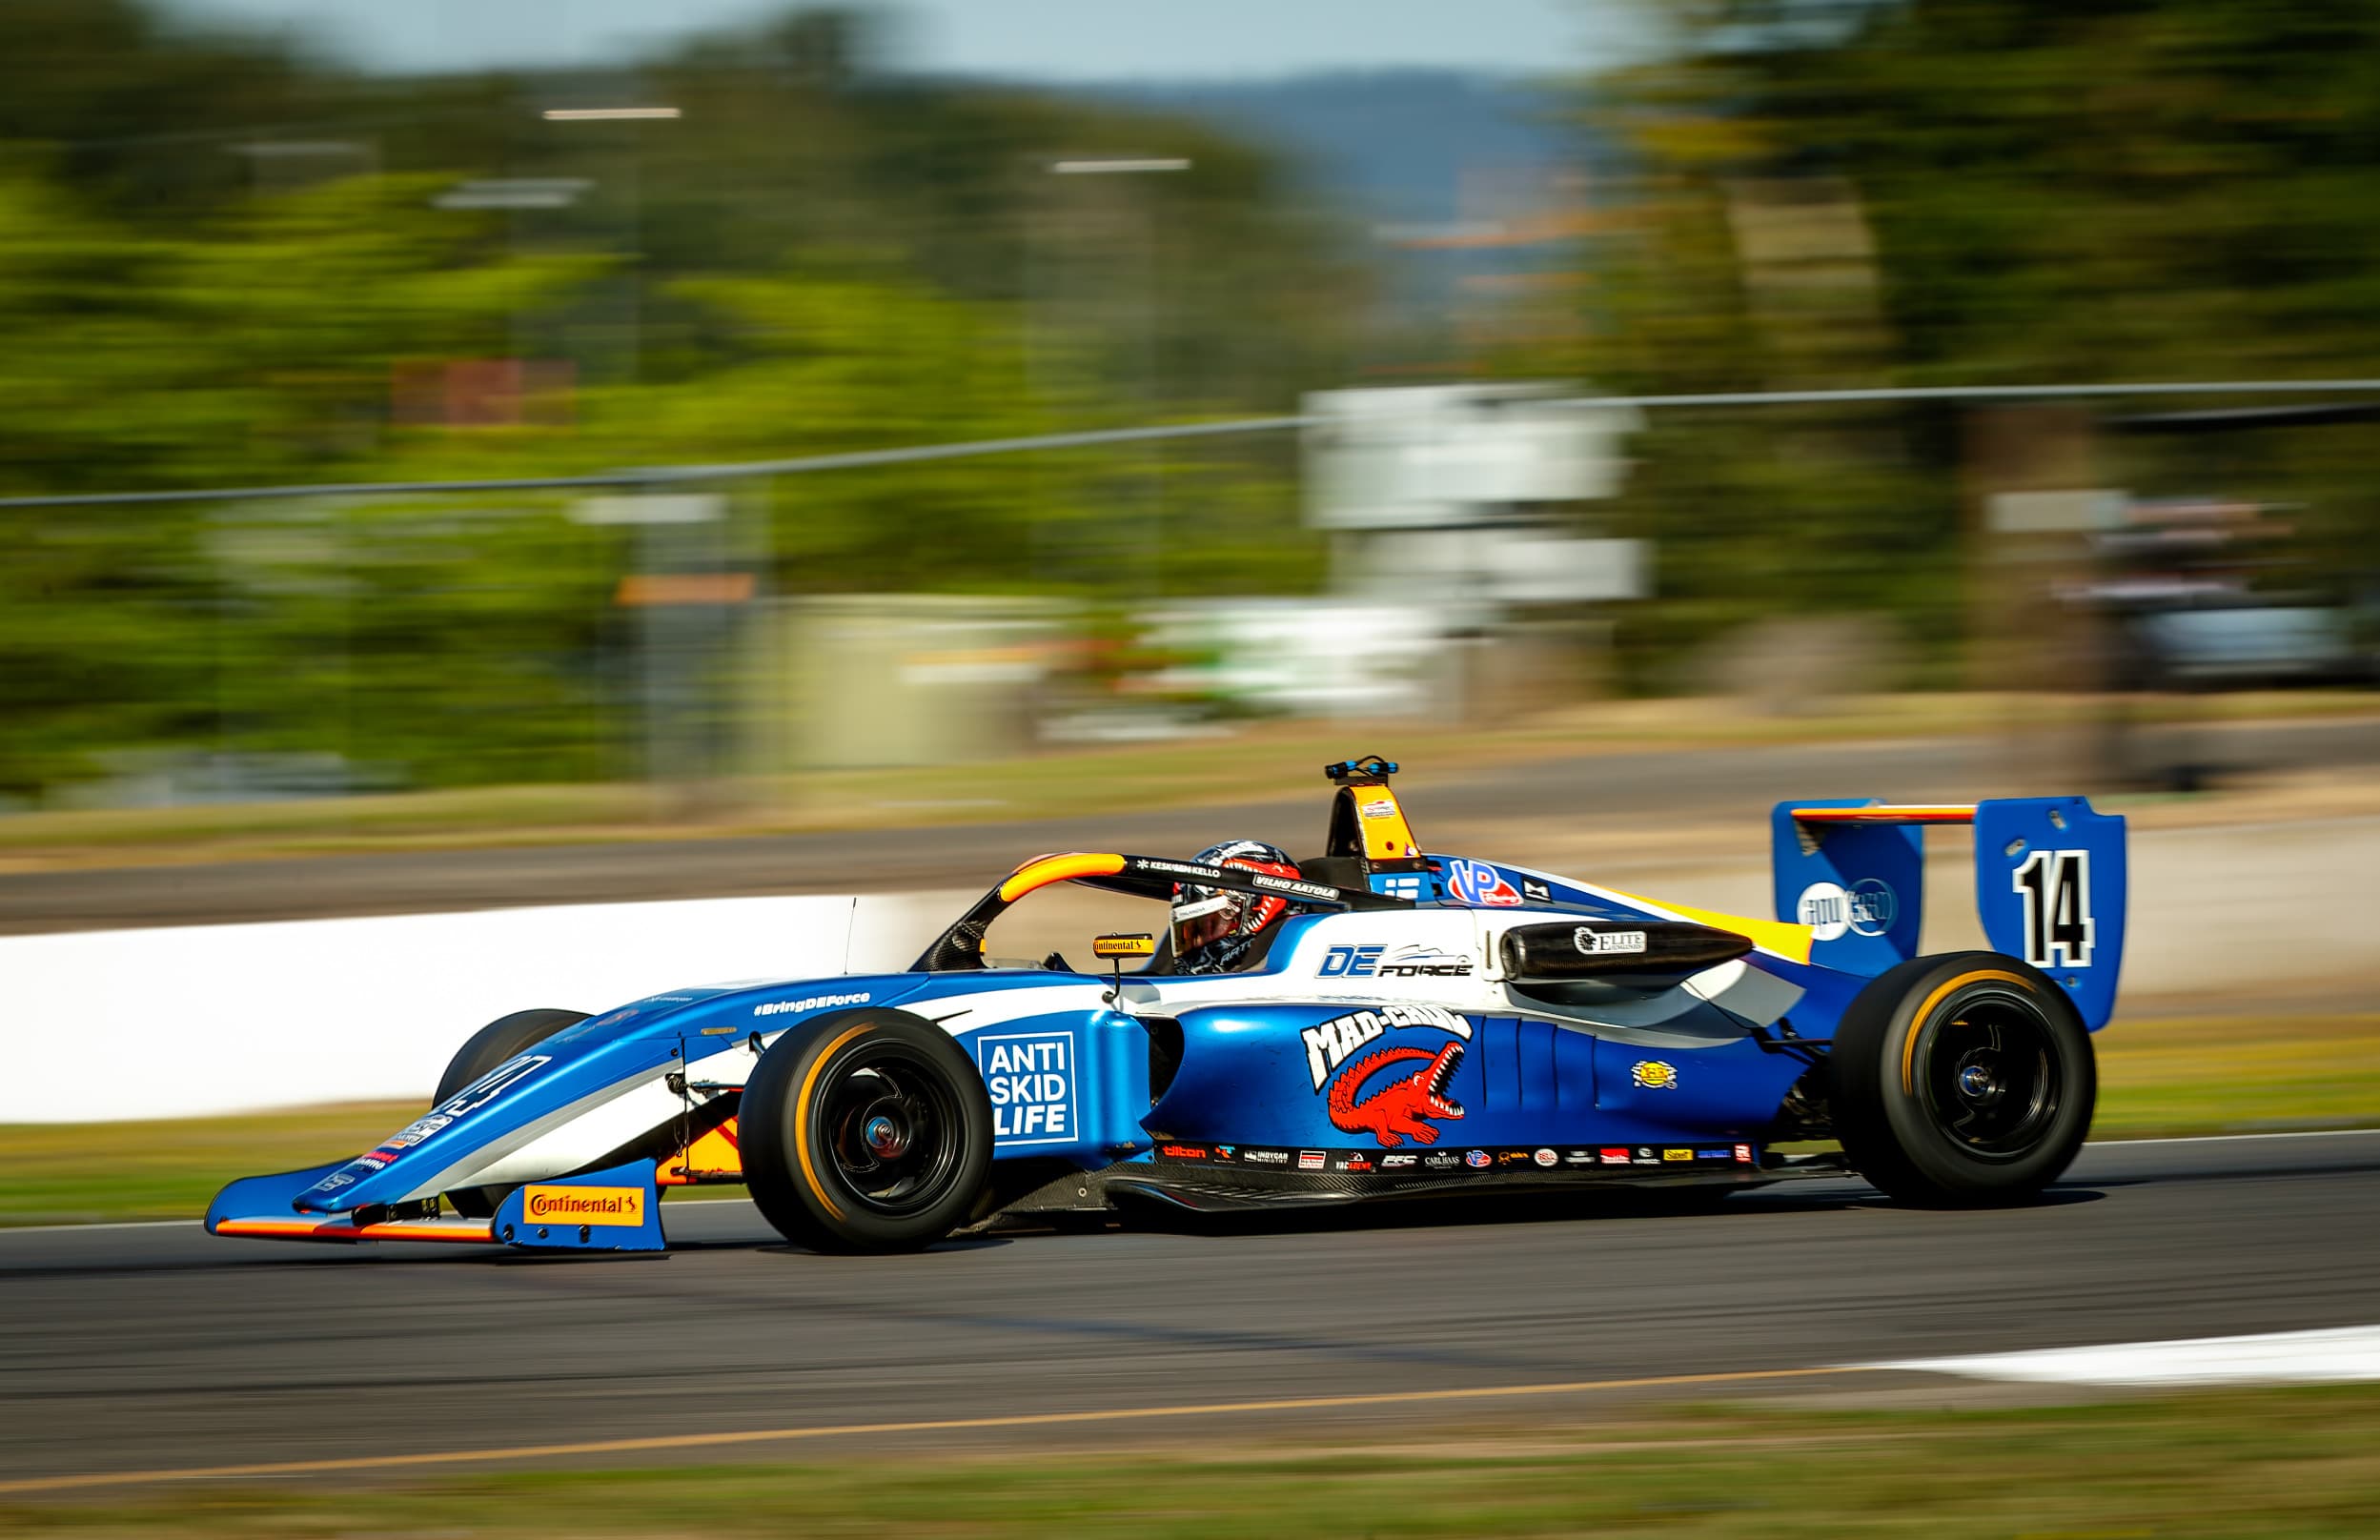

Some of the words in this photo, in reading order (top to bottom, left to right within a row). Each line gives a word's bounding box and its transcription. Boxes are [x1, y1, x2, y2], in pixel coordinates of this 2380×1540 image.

[1191, 866, 1221, 878] KELLO
[1450, 860, 1498, 903] VP
[1255, 876, 1292, 889] VILHO
[1291, 882, 1335, 898] AATOLA
[2012, 850, 2095, 968] 14
[1599, 935, 1642, 951] ELITE
[1314, 943, 1388, 979] DE
[1378, 964, 1474, 977] FORCE
[754, 992, 870, 1016] #BringDEForce
[989, 1043, 1066, 1074] ANTI
[1300, 1004, 1474, 1096] MAD-CROC
[989, 1074, 1067, 1104] SKID
[994, 1104, 1068, 1136] LIFE
[1162, 1145, 1207, 1159] tilton
[1257, 1150, 1289, 1159] INDYCAR
[1466, 1149, 1484, 1165] VP
[530, 1193, 621, 1216] Continental
